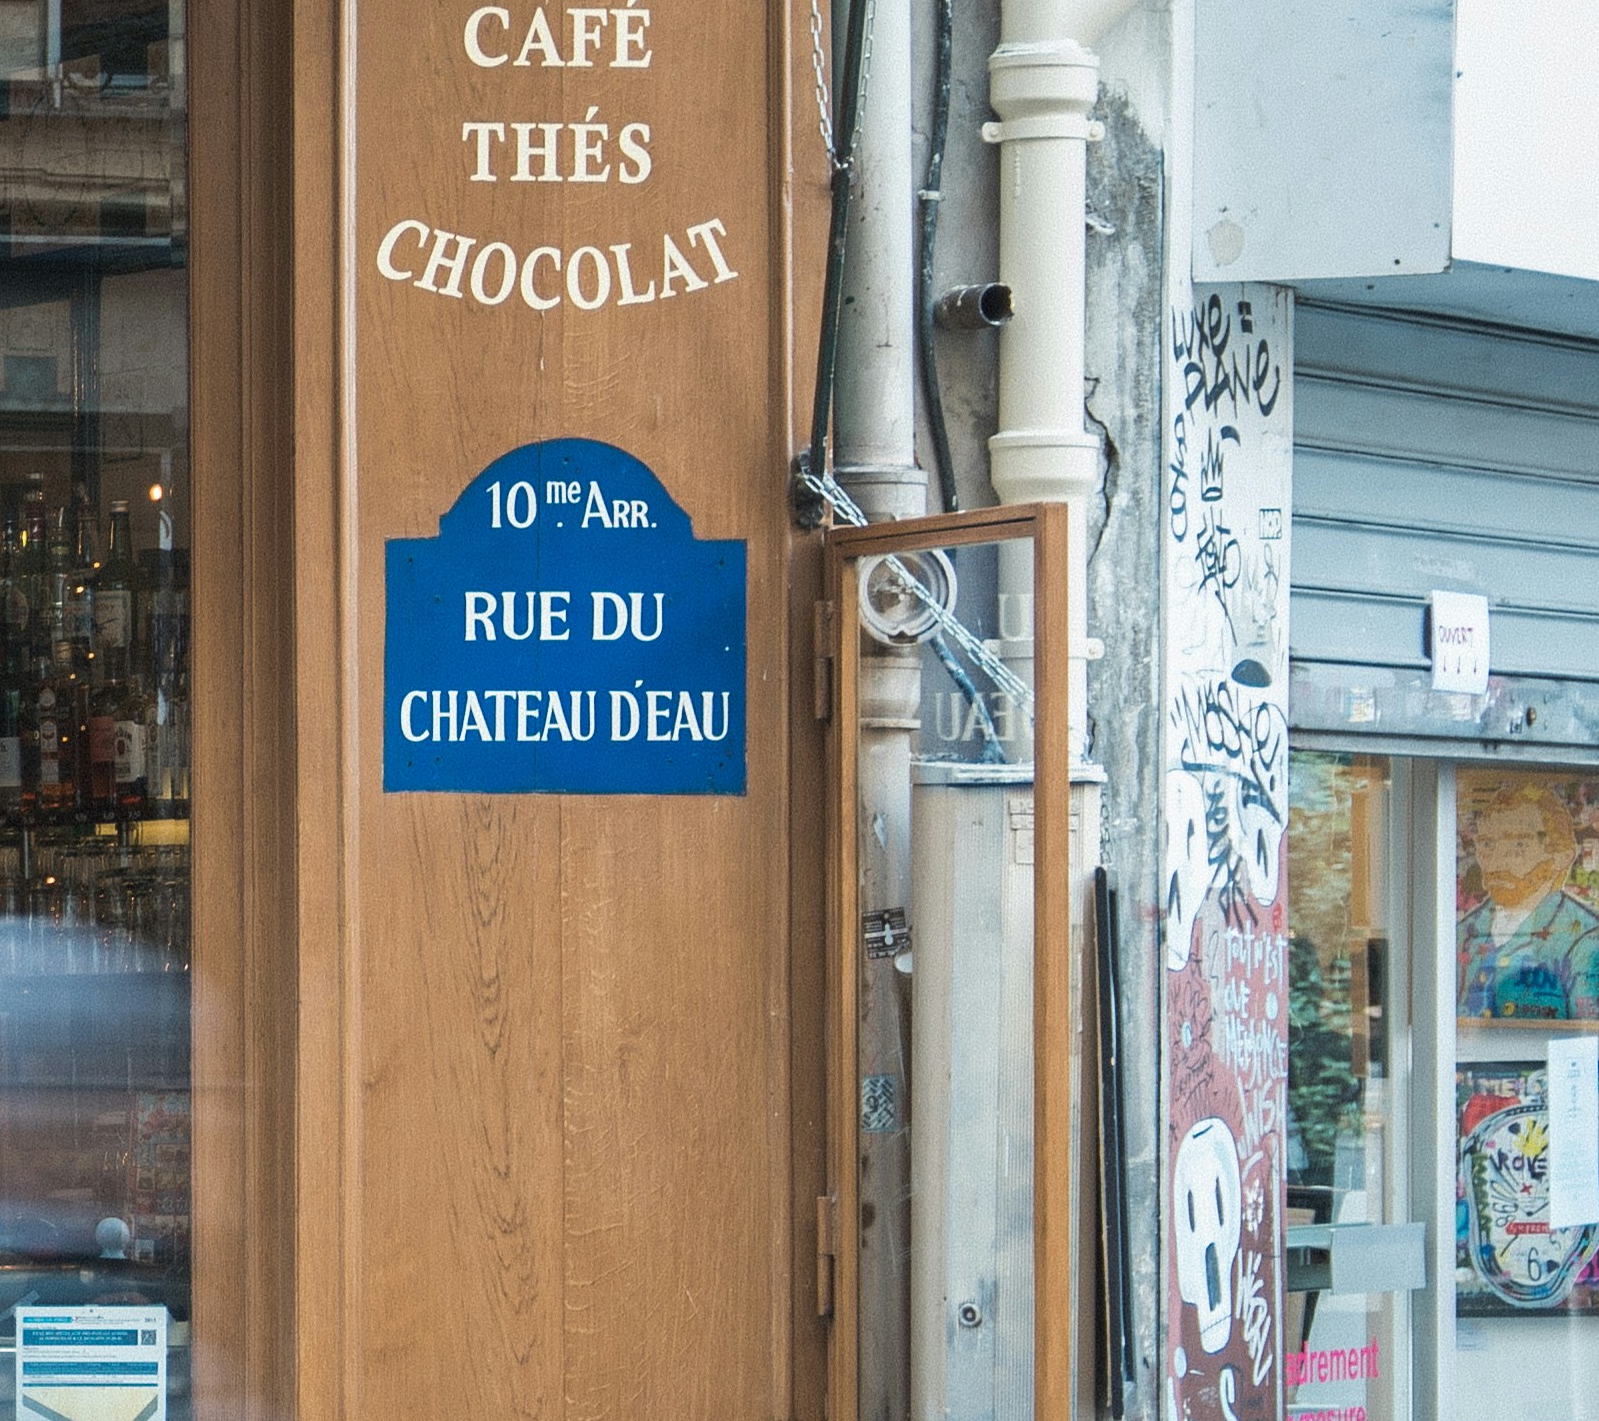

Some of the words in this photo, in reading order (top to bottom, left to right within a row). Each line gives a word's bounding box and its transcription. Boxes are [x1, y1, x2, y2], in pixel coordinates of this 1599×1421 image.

[461, 105, 652, 185] THÉS
[375, 218, 740, 311] CHOCOLAT
[465, 591, 570, 641] RUE
[591, 591, 664, 642] DU
[1439, 625, 1473, 648] OUVERT
[400, 690, 596, 742] CHATEAU
[609, 679, 730, 741] D'EAU
